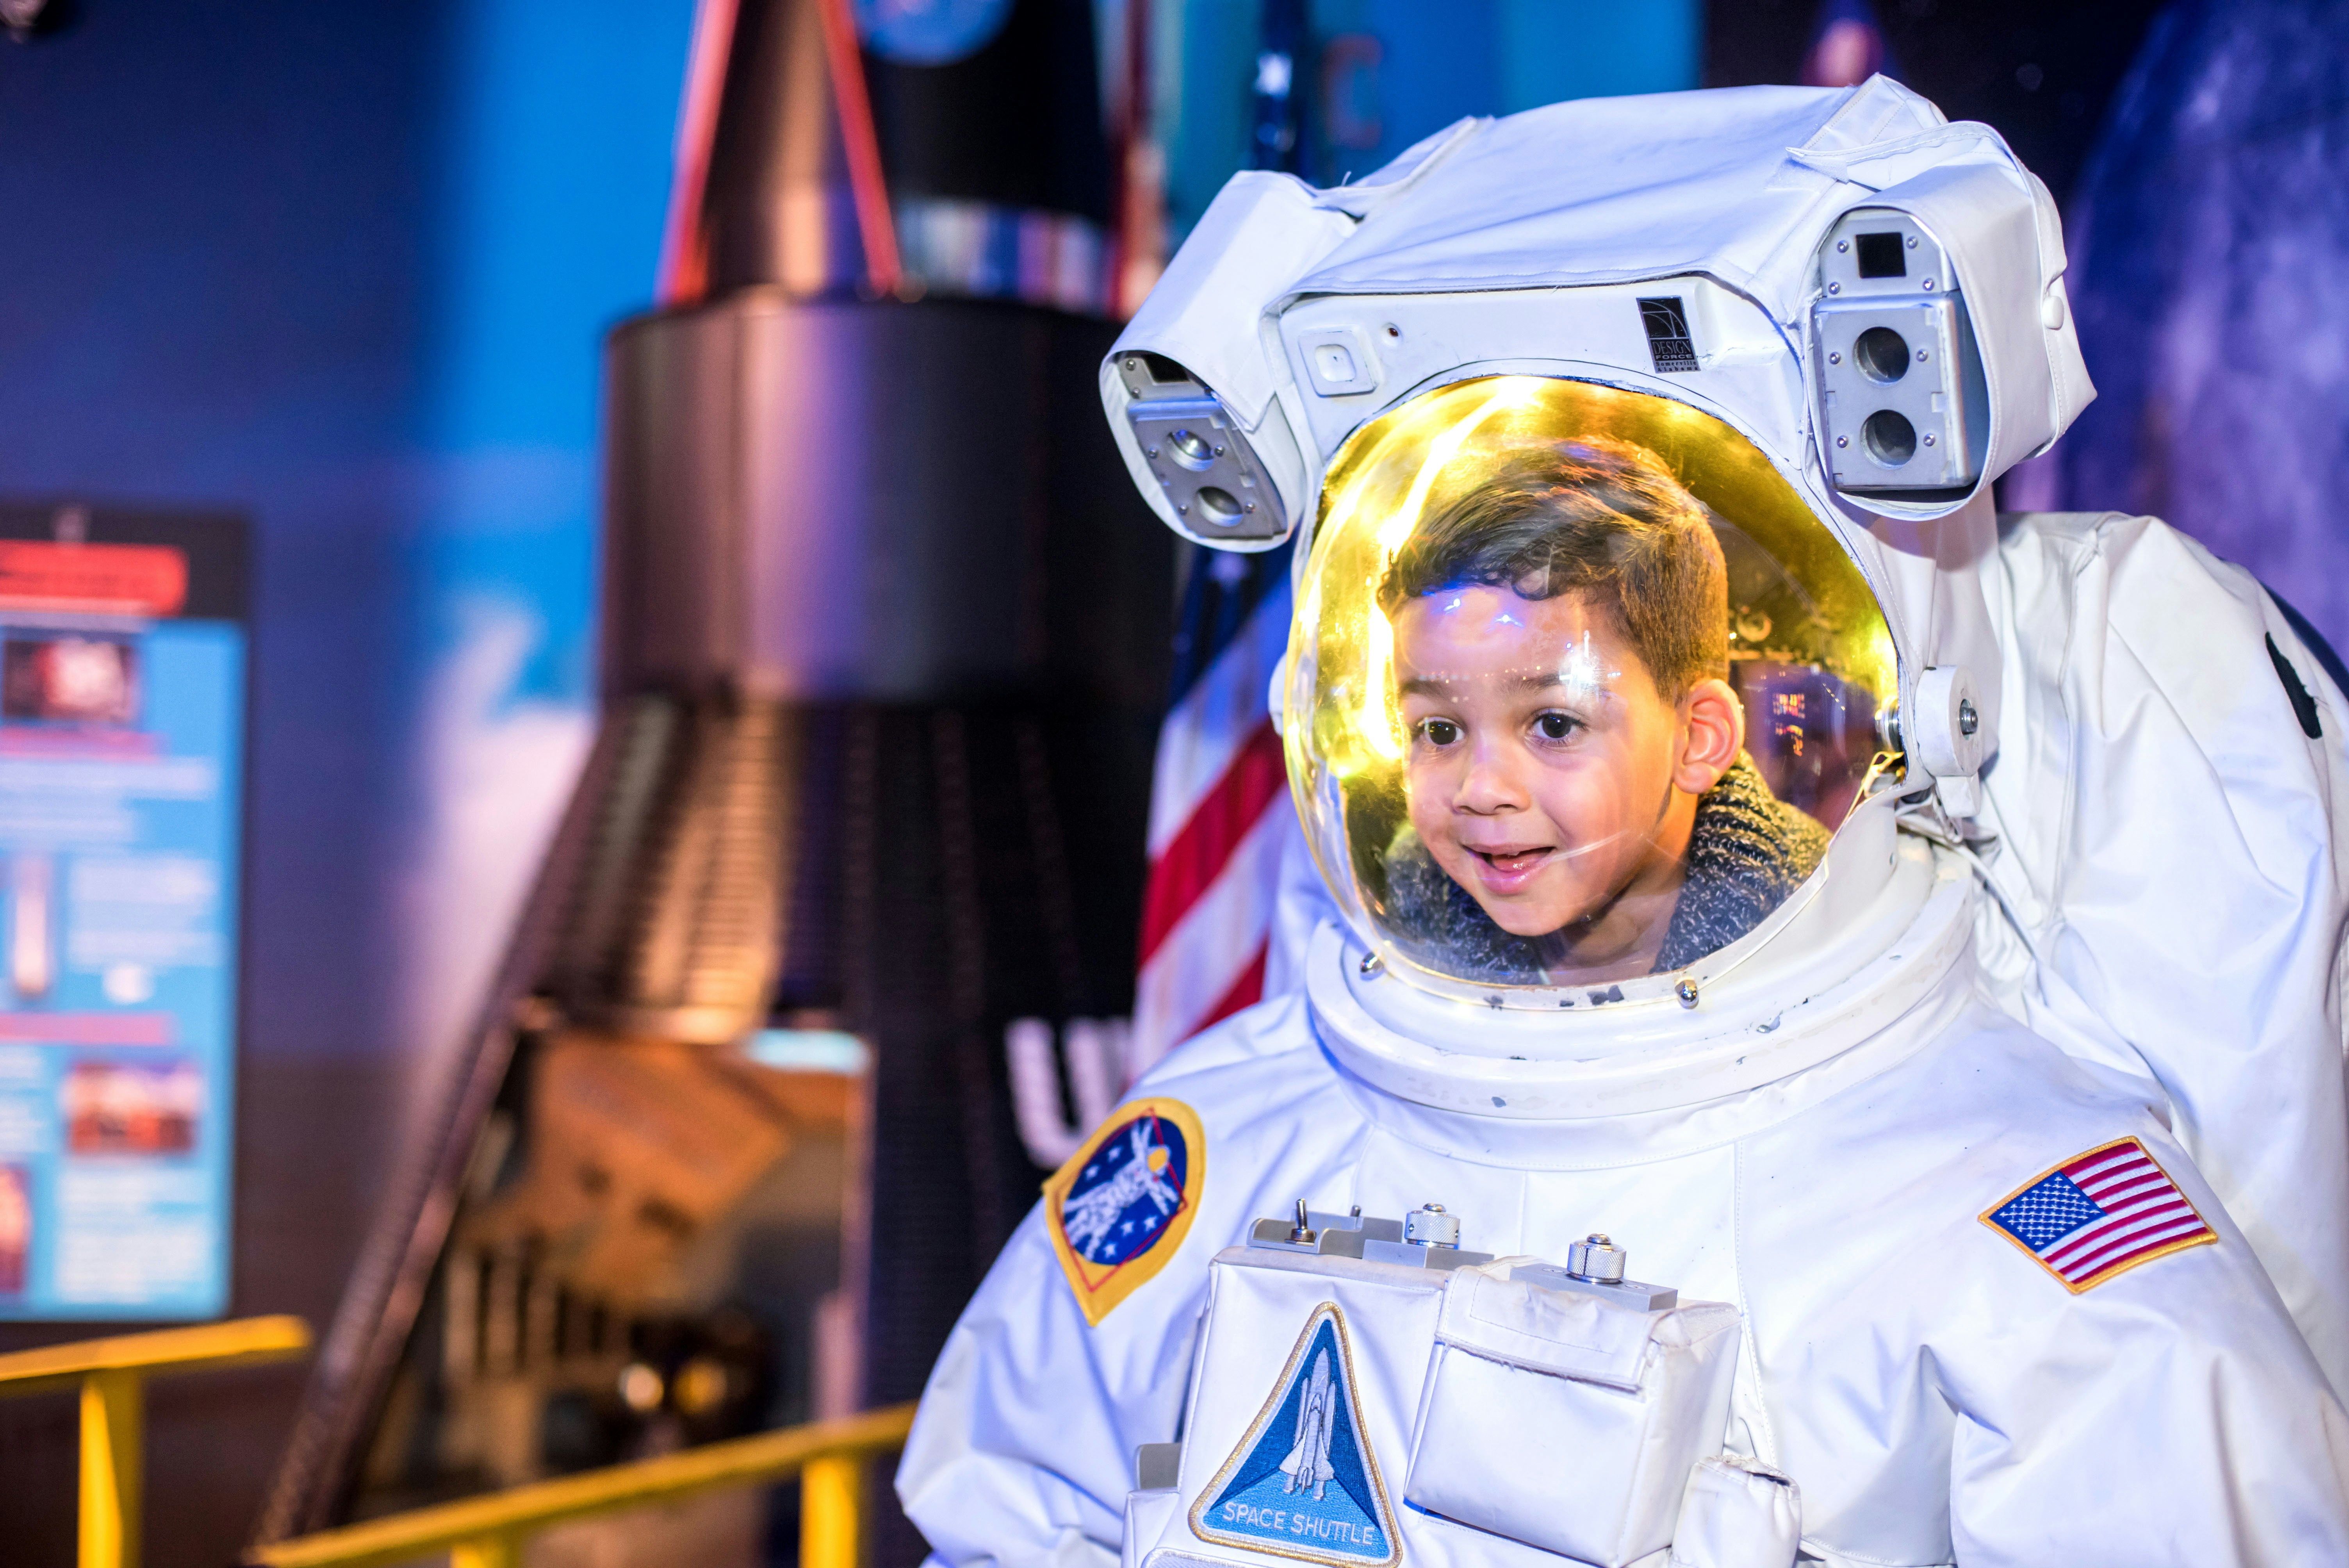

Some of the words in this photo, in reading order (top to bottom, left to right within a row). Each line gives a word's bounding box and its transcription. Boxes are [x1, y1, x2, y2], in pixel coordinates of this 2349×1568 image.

[1652, 341, 1691, 354] DESIGN
[1223, 1502, 1286, 1530] SPACE
[1290, 1514, 1375, 1545] SHUTTLE
